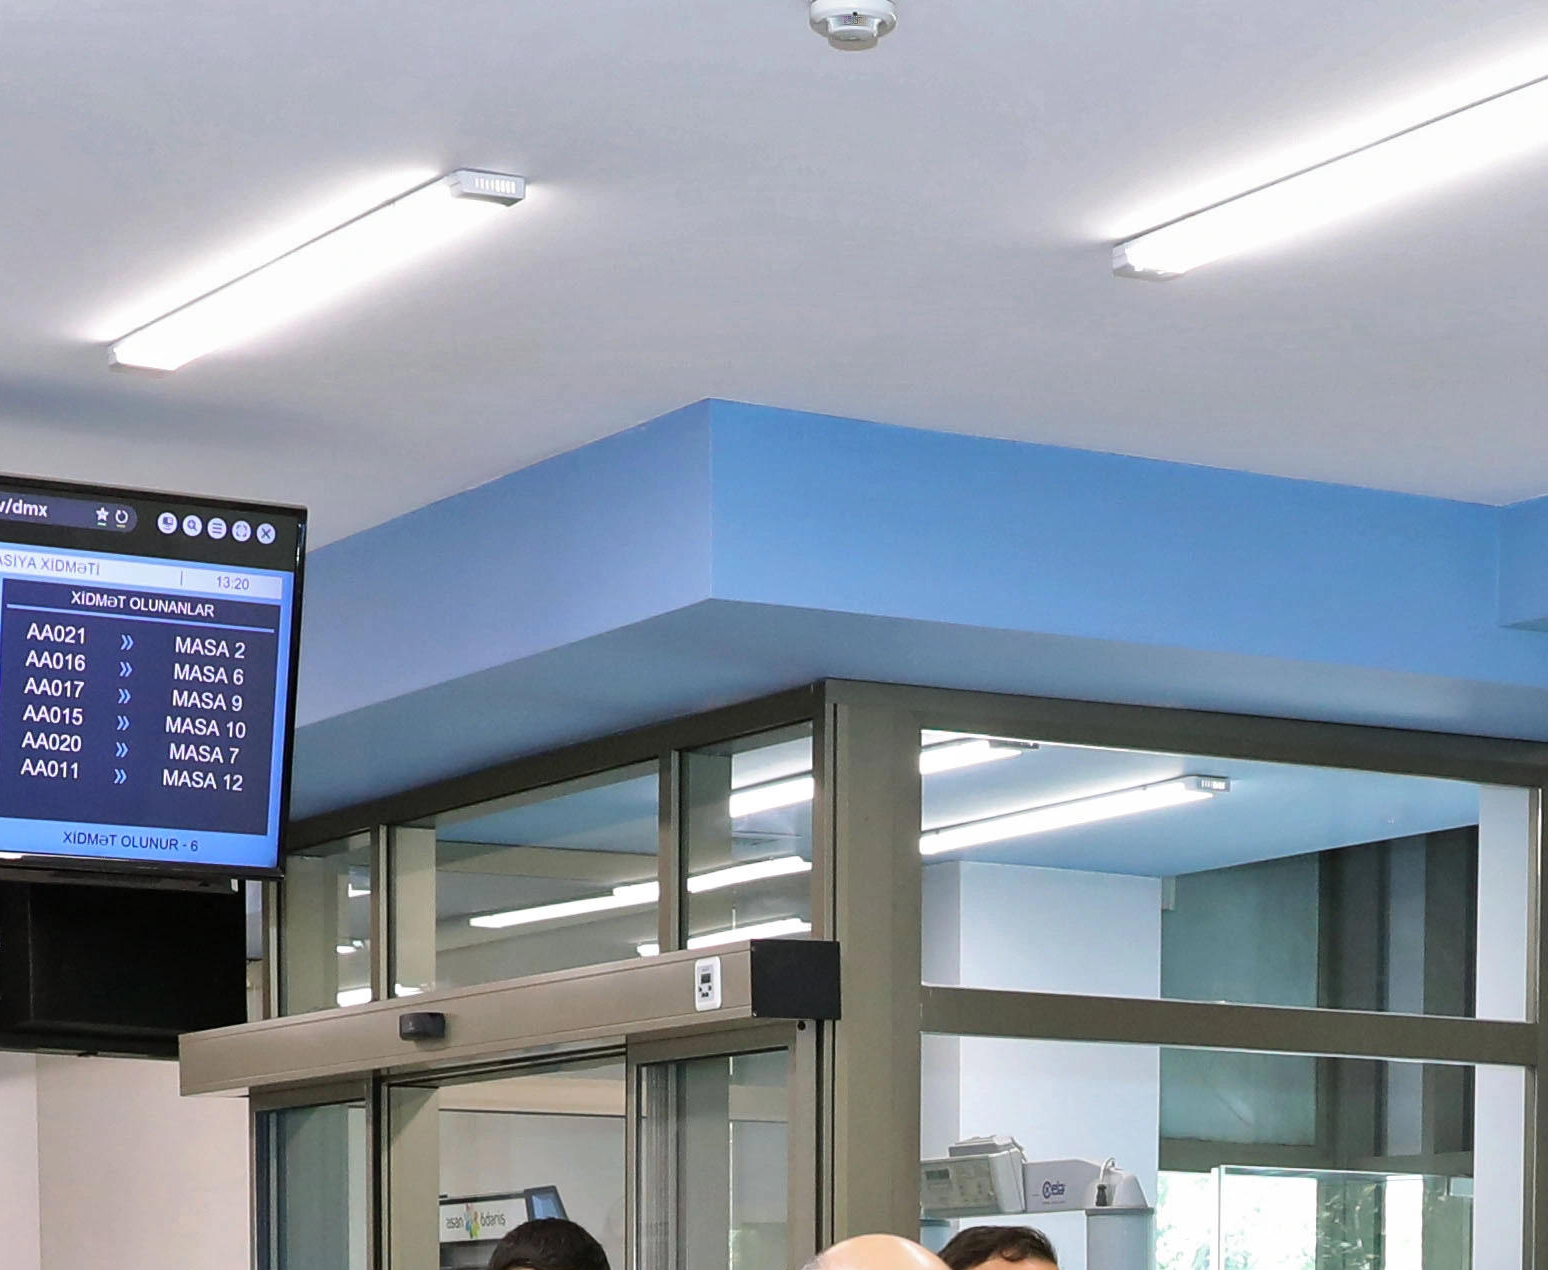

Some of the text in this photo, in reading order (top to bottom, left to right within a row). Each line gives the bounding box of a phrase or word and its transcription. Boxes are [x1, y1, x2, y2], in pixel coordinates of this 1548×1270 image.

[216, 576, 250, 591] 13:20
[129, 596, 215, 618] OLUNANLAR
[26, 622, 246, 659] AA021 MASA 2
[25, 649, 244, 686] AA016 MASA 6
[23, 677, 243, 712] AA017 MASA 9
[22, 704, 246, 739] AA015 MASA 10
[21, 731, 240, 764] AA020 MASA 7
[20, 758, 243, 791] AA011 MASA 12
[120, 834, 179, 851] OLUNUR
[190, 840, 198, 852] 6
